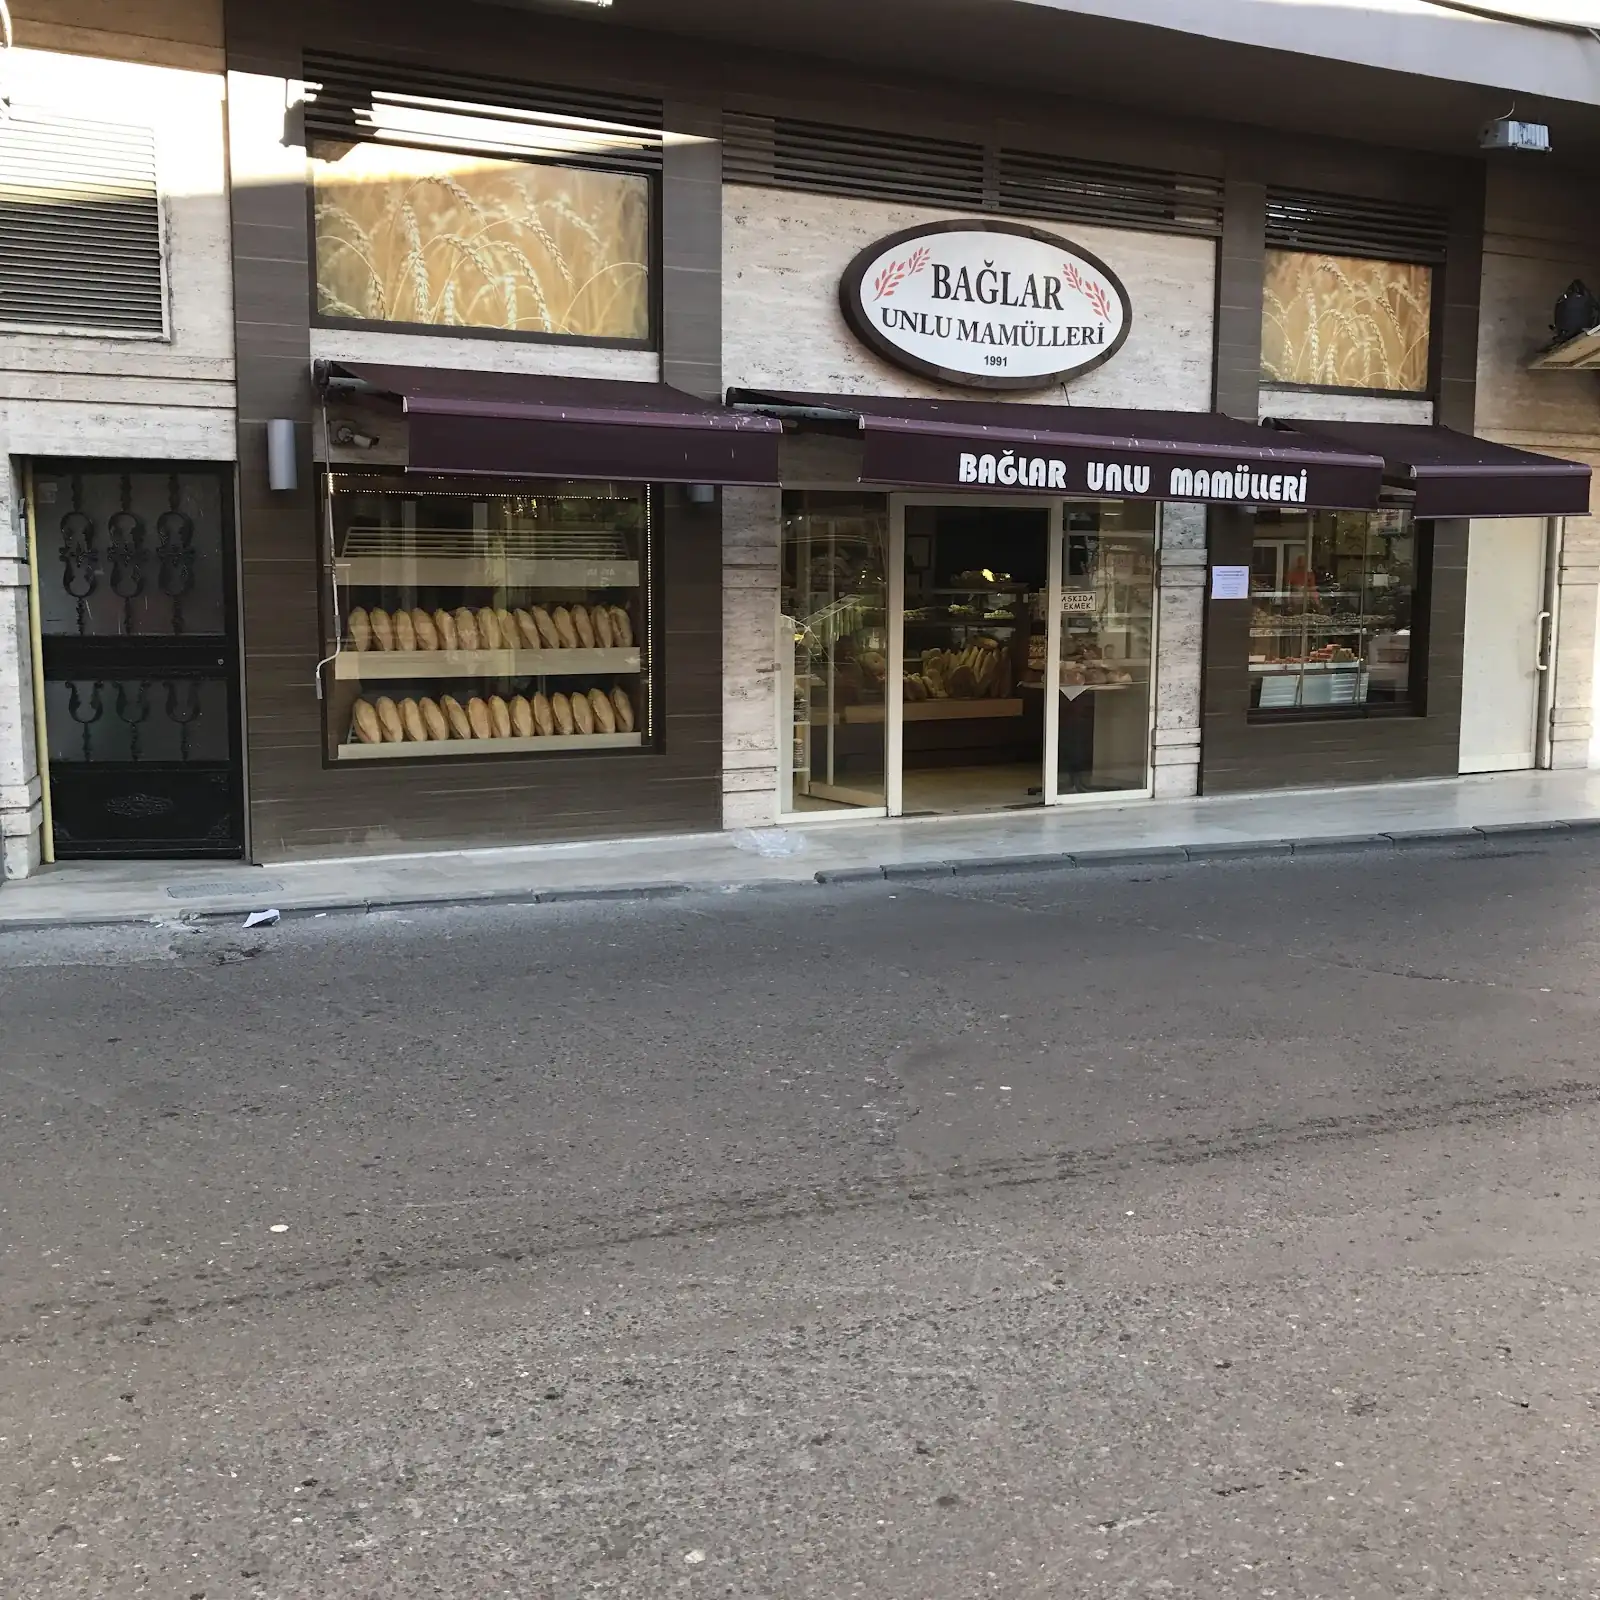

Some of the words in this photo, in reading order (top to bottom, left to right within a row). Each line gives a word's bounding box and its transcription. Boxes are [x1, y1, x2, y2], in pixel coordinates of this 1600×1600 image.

[932, 259, 1064, 311] BAĞLAR
[881, 307, 953, 338] UNLU
[956, 320, 1105, 348] MAMÜLLERİ
[983, 354, 1008, 367] 1991
[958, 450, 1066, 488] BAĞLAR
[1086, 461, 1150, 494] UNLU
[1170, 465, 1308, 502] MAMÜLLERİ
[1064, 602, 1091, 610] EKMEK
